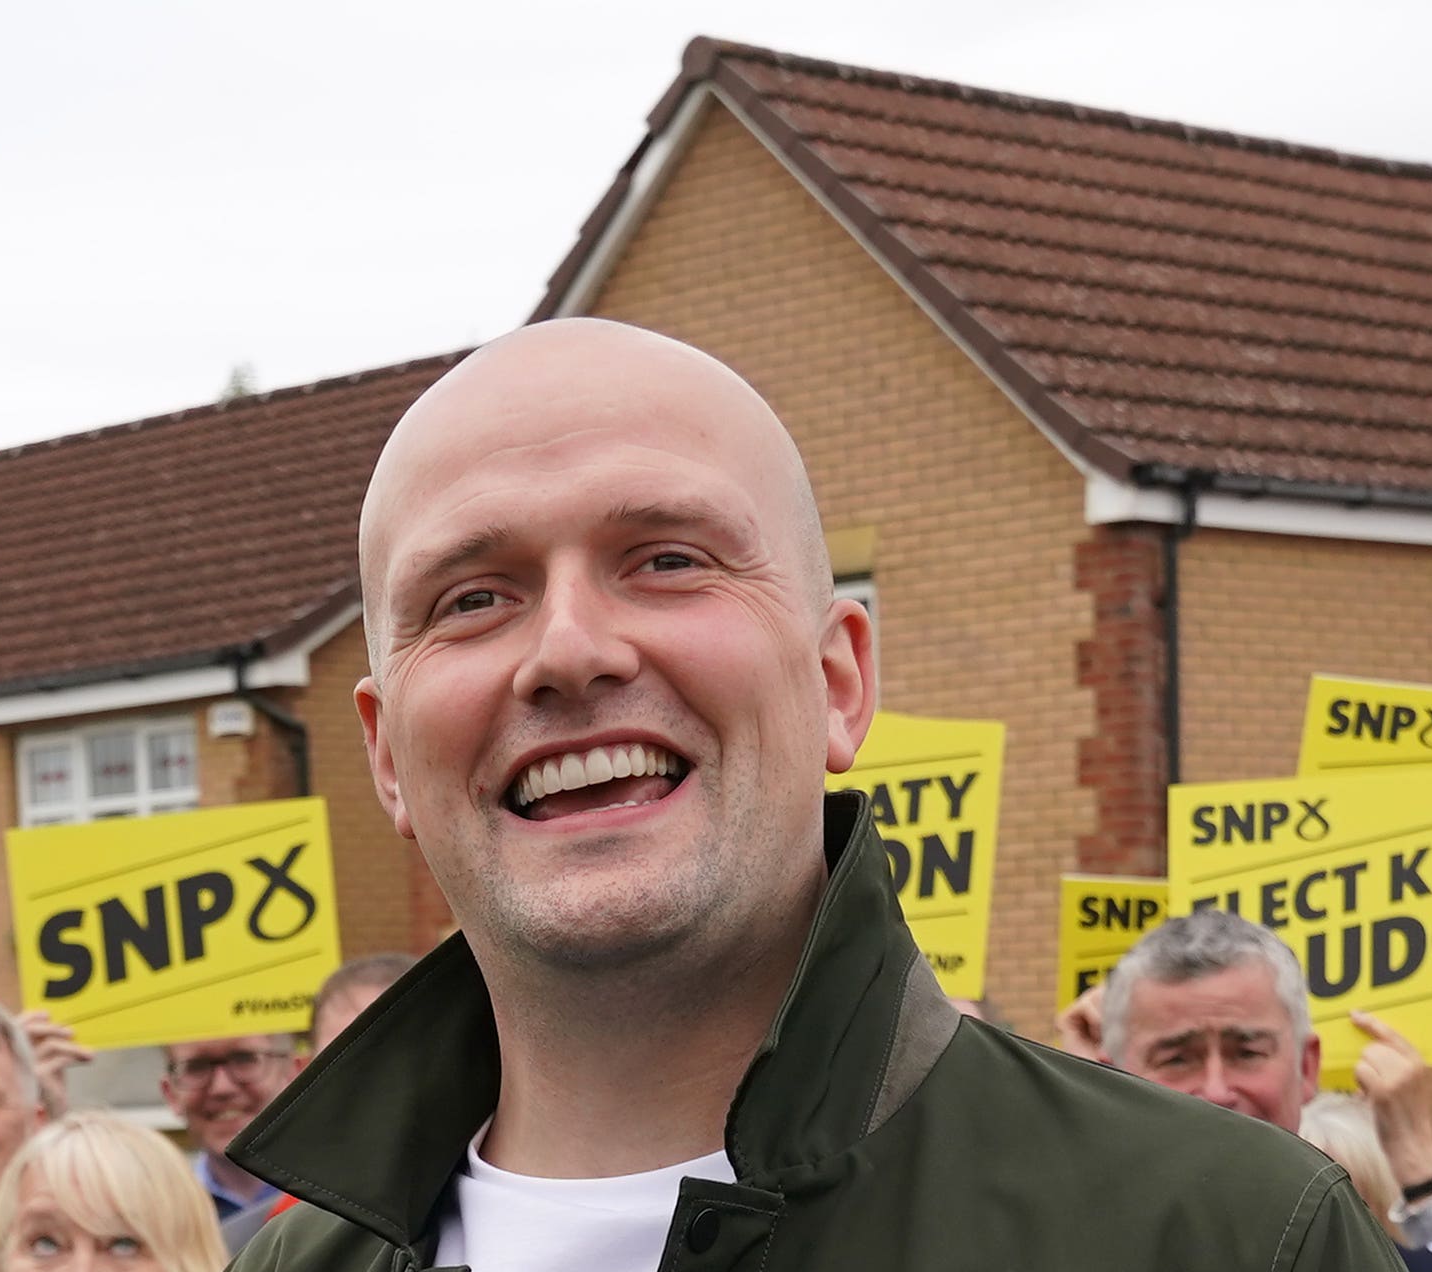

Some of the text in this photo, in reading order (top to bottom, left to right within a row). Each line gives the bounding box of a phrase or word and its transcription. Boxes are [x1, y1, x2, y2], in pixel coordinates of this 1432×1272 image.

[1326, 698, 1418, 744] SNP
[871, 772, 978, 827] ATY
[1191, 802, 1289, 847] SNP
[38, 869, 236, 1000] SNP
[1078, 895, 1158, 931] SNP
